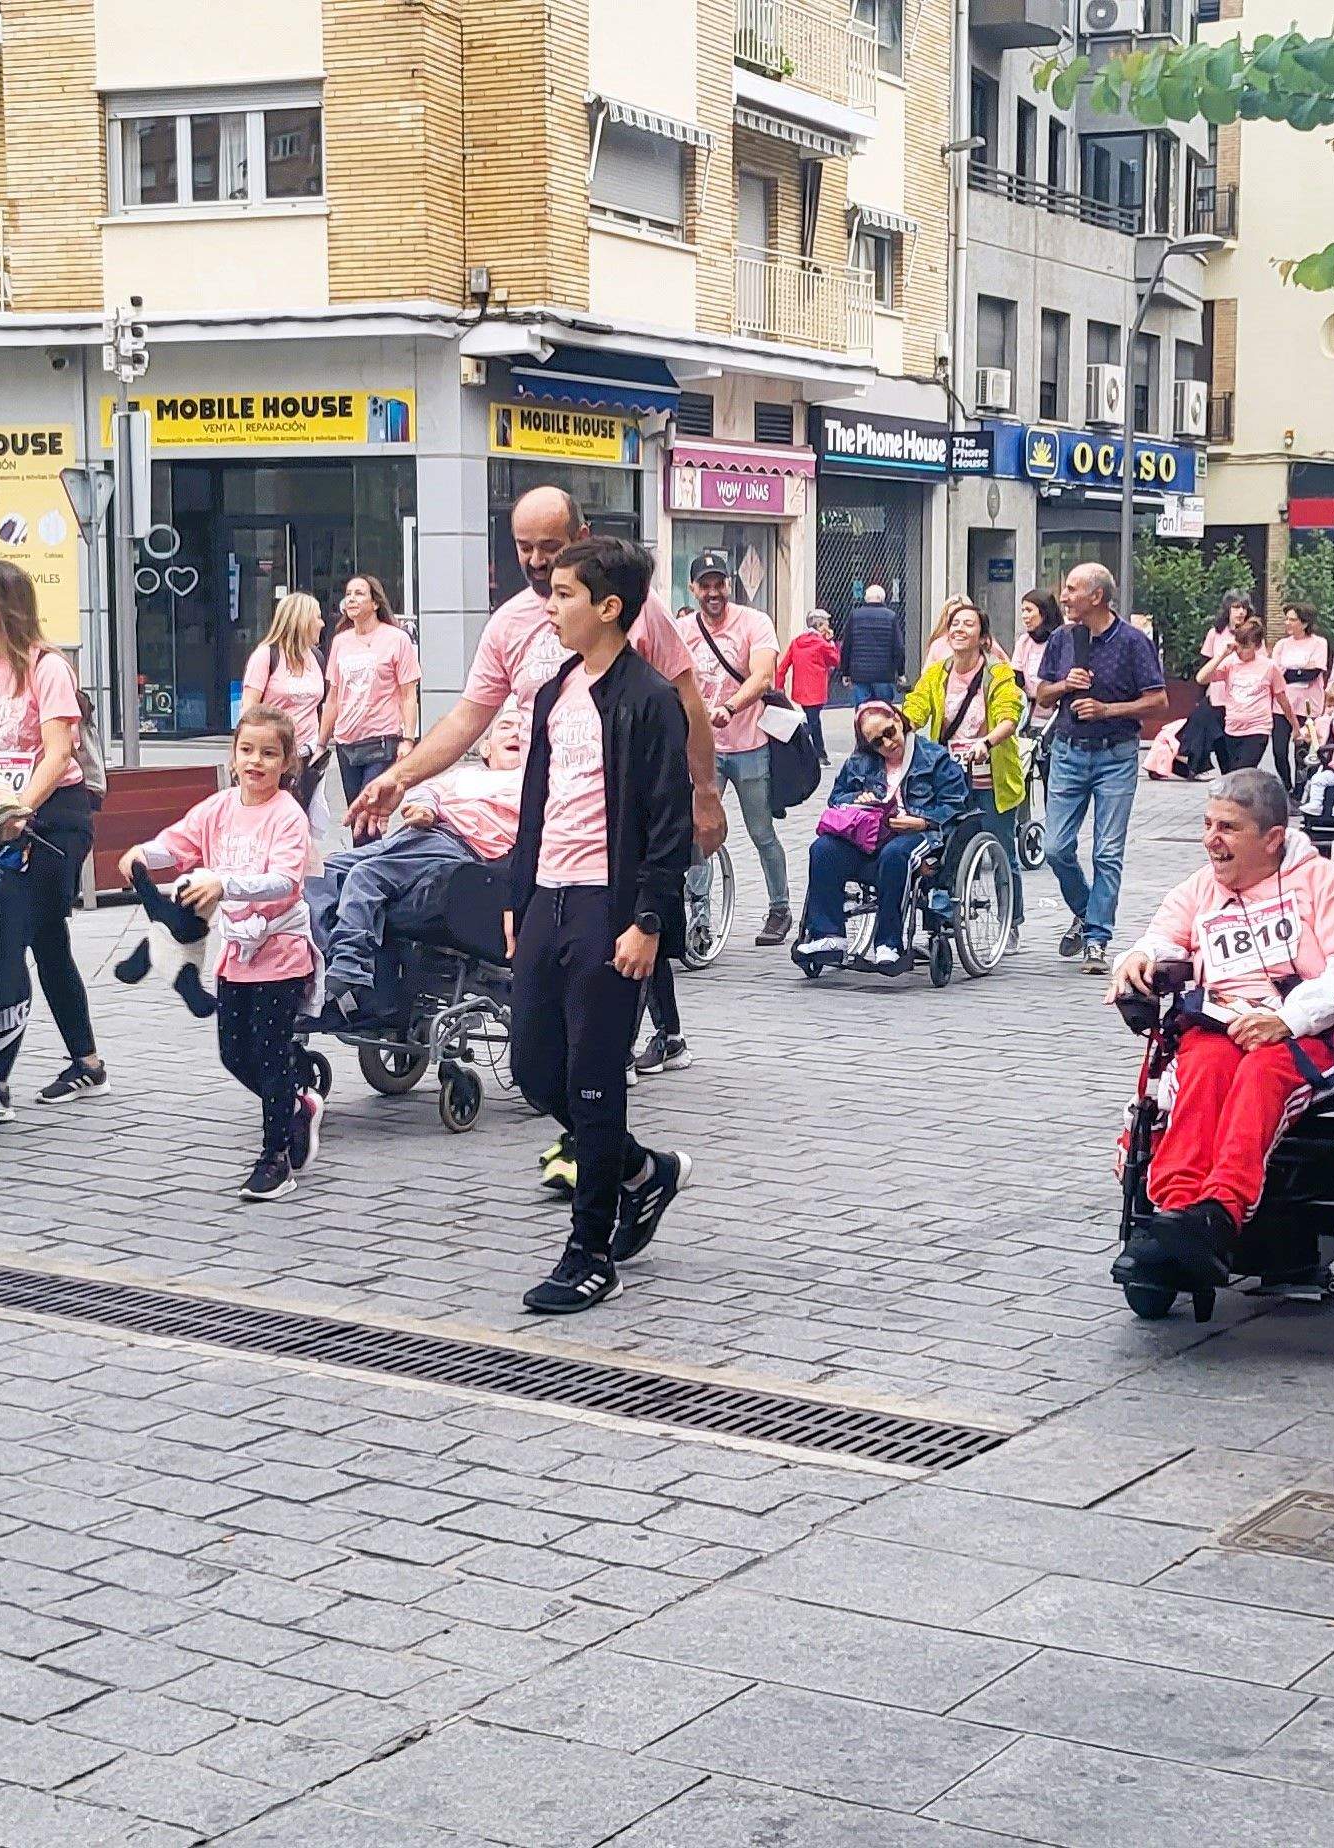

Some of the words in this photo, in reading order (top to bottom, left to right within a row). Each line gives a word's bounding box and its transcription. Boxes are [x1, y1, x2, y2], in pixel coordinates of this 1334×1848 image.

[156, 397, 254, 420] MOBILE
[262, 396, 353, 419] HOUSE
[202, 424, 235, 433] VENTA
[245, 420, 307, 432] REPARACIÓN
[520, 409, 570, 435] MOBILE
[573, 416, 616, 440] HOUSE
[824, 419, 856, 452] The
[856, 423, 903, 459] Phone
[903, 429, 947, 463] House
[952, 437, 976, 448] The
[952, 447, 989, 459] Phone
[952, 458, 989, 469] House
[716, 481, 742, 499] WOW
[745, 479, 770, 501] UÑAS
[1213, 917, 1293, 959] 1810
